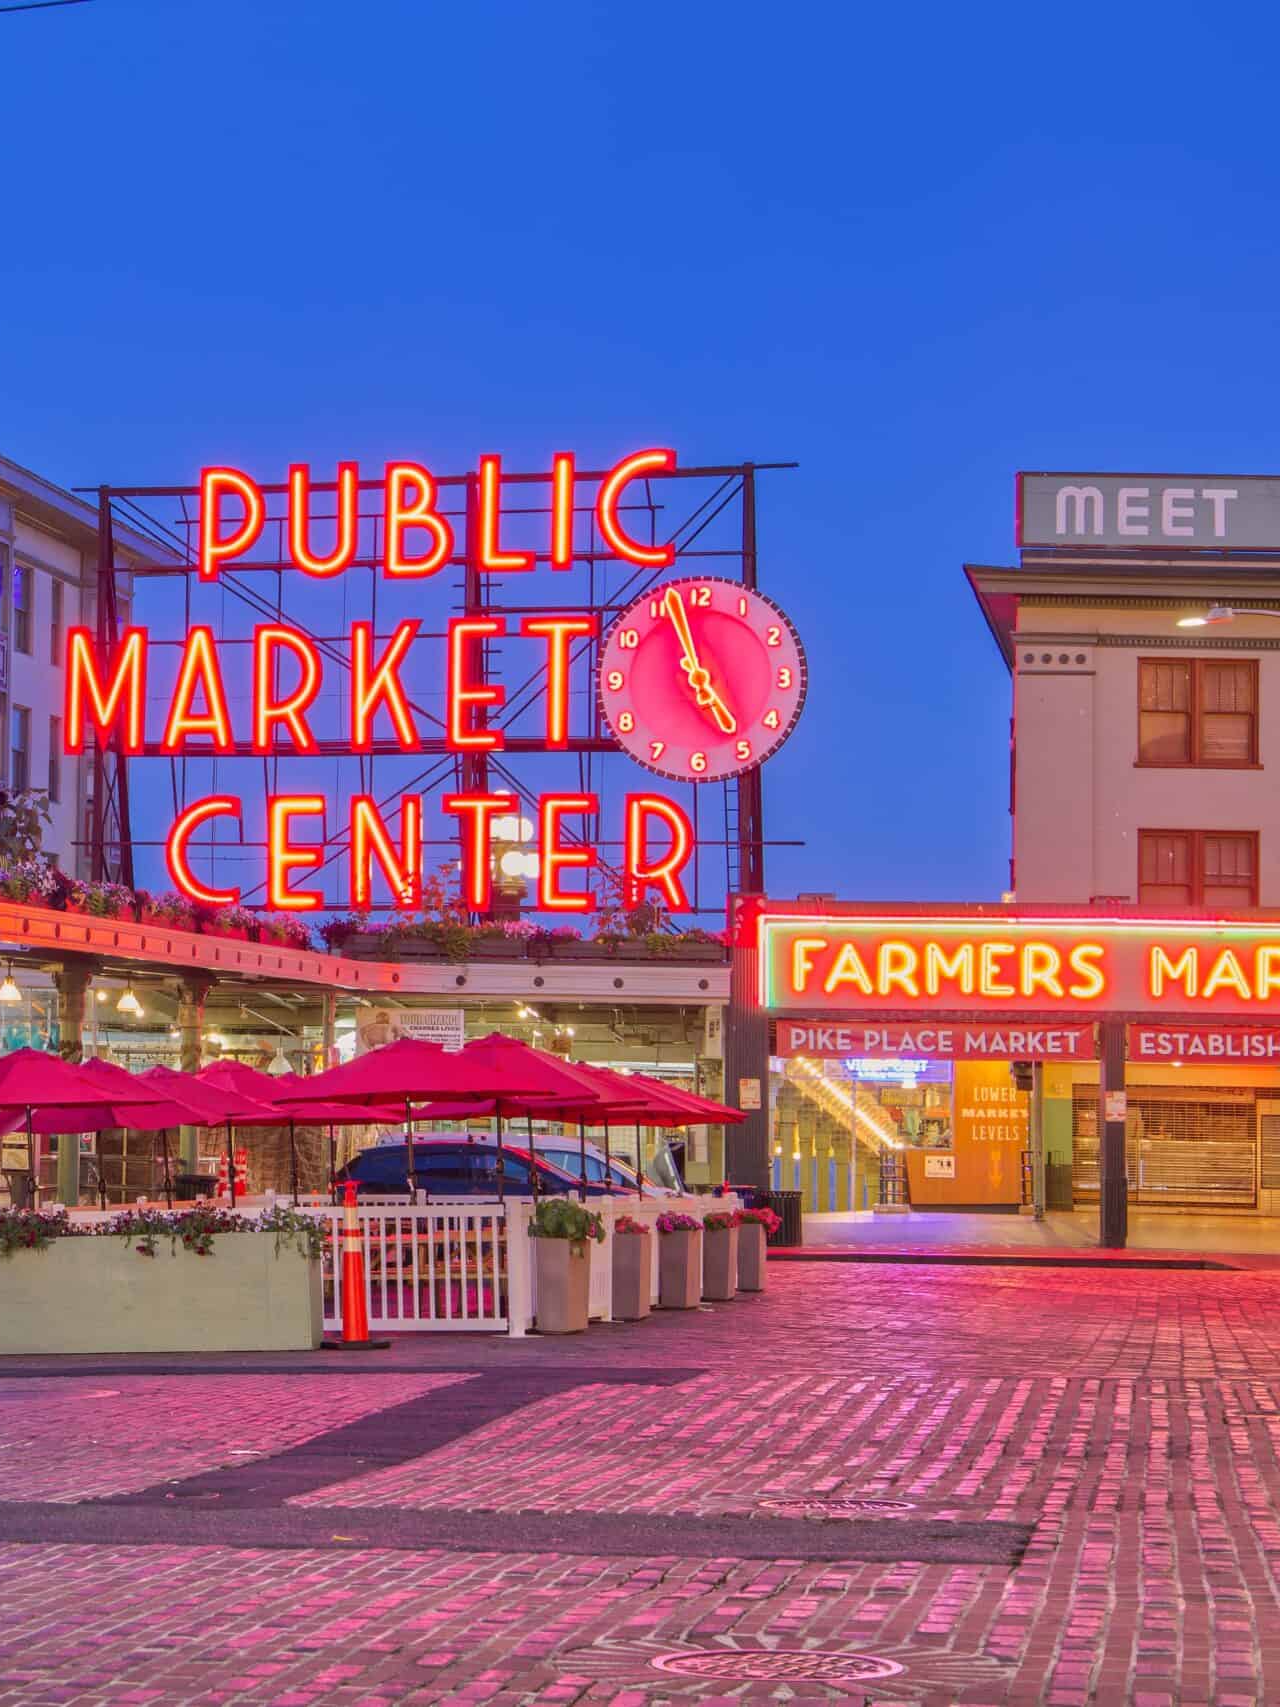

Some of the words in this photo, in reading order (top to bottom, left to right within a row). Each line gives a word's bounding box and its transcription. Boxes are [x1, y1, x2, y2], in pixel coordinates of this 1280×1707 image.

[198, 449, 677, 583] PUBLIC
[1056, 486, 1238, 536] MEET
[691, 588, 711, 606] 12
[650, 601, 666, 617] 11
[739, 598, 747, 616] 1
[619, 630, 639, 649] 10
[767, 627, 781, 646] 2
[64, 614, 599, 755] MARKET
[608, 671, 623, 691] 9
[778, 668, 791, 688] 3
[619, 712, 634, 732] 8
[764, 710, 778, 729] 4
[651, 743, 664, 760] 7
[736, 741, 751, 759] 5
[691, 753, 706, 772] 6
[166, 793, 694, 914] CENTER
[791, 938, 1106, 998] FARMERS
[790, 1030, 852, 1050] PIKE
[864, 1031, 953, 1052] PLACE
[964, 1032, 1080, 1054] MARKET
[974, 1087, 1017, 1102] LOWER
[961, 1108, 1029, 1118] MARKET
[971, 1125, 1020, 1141] LEVELS
